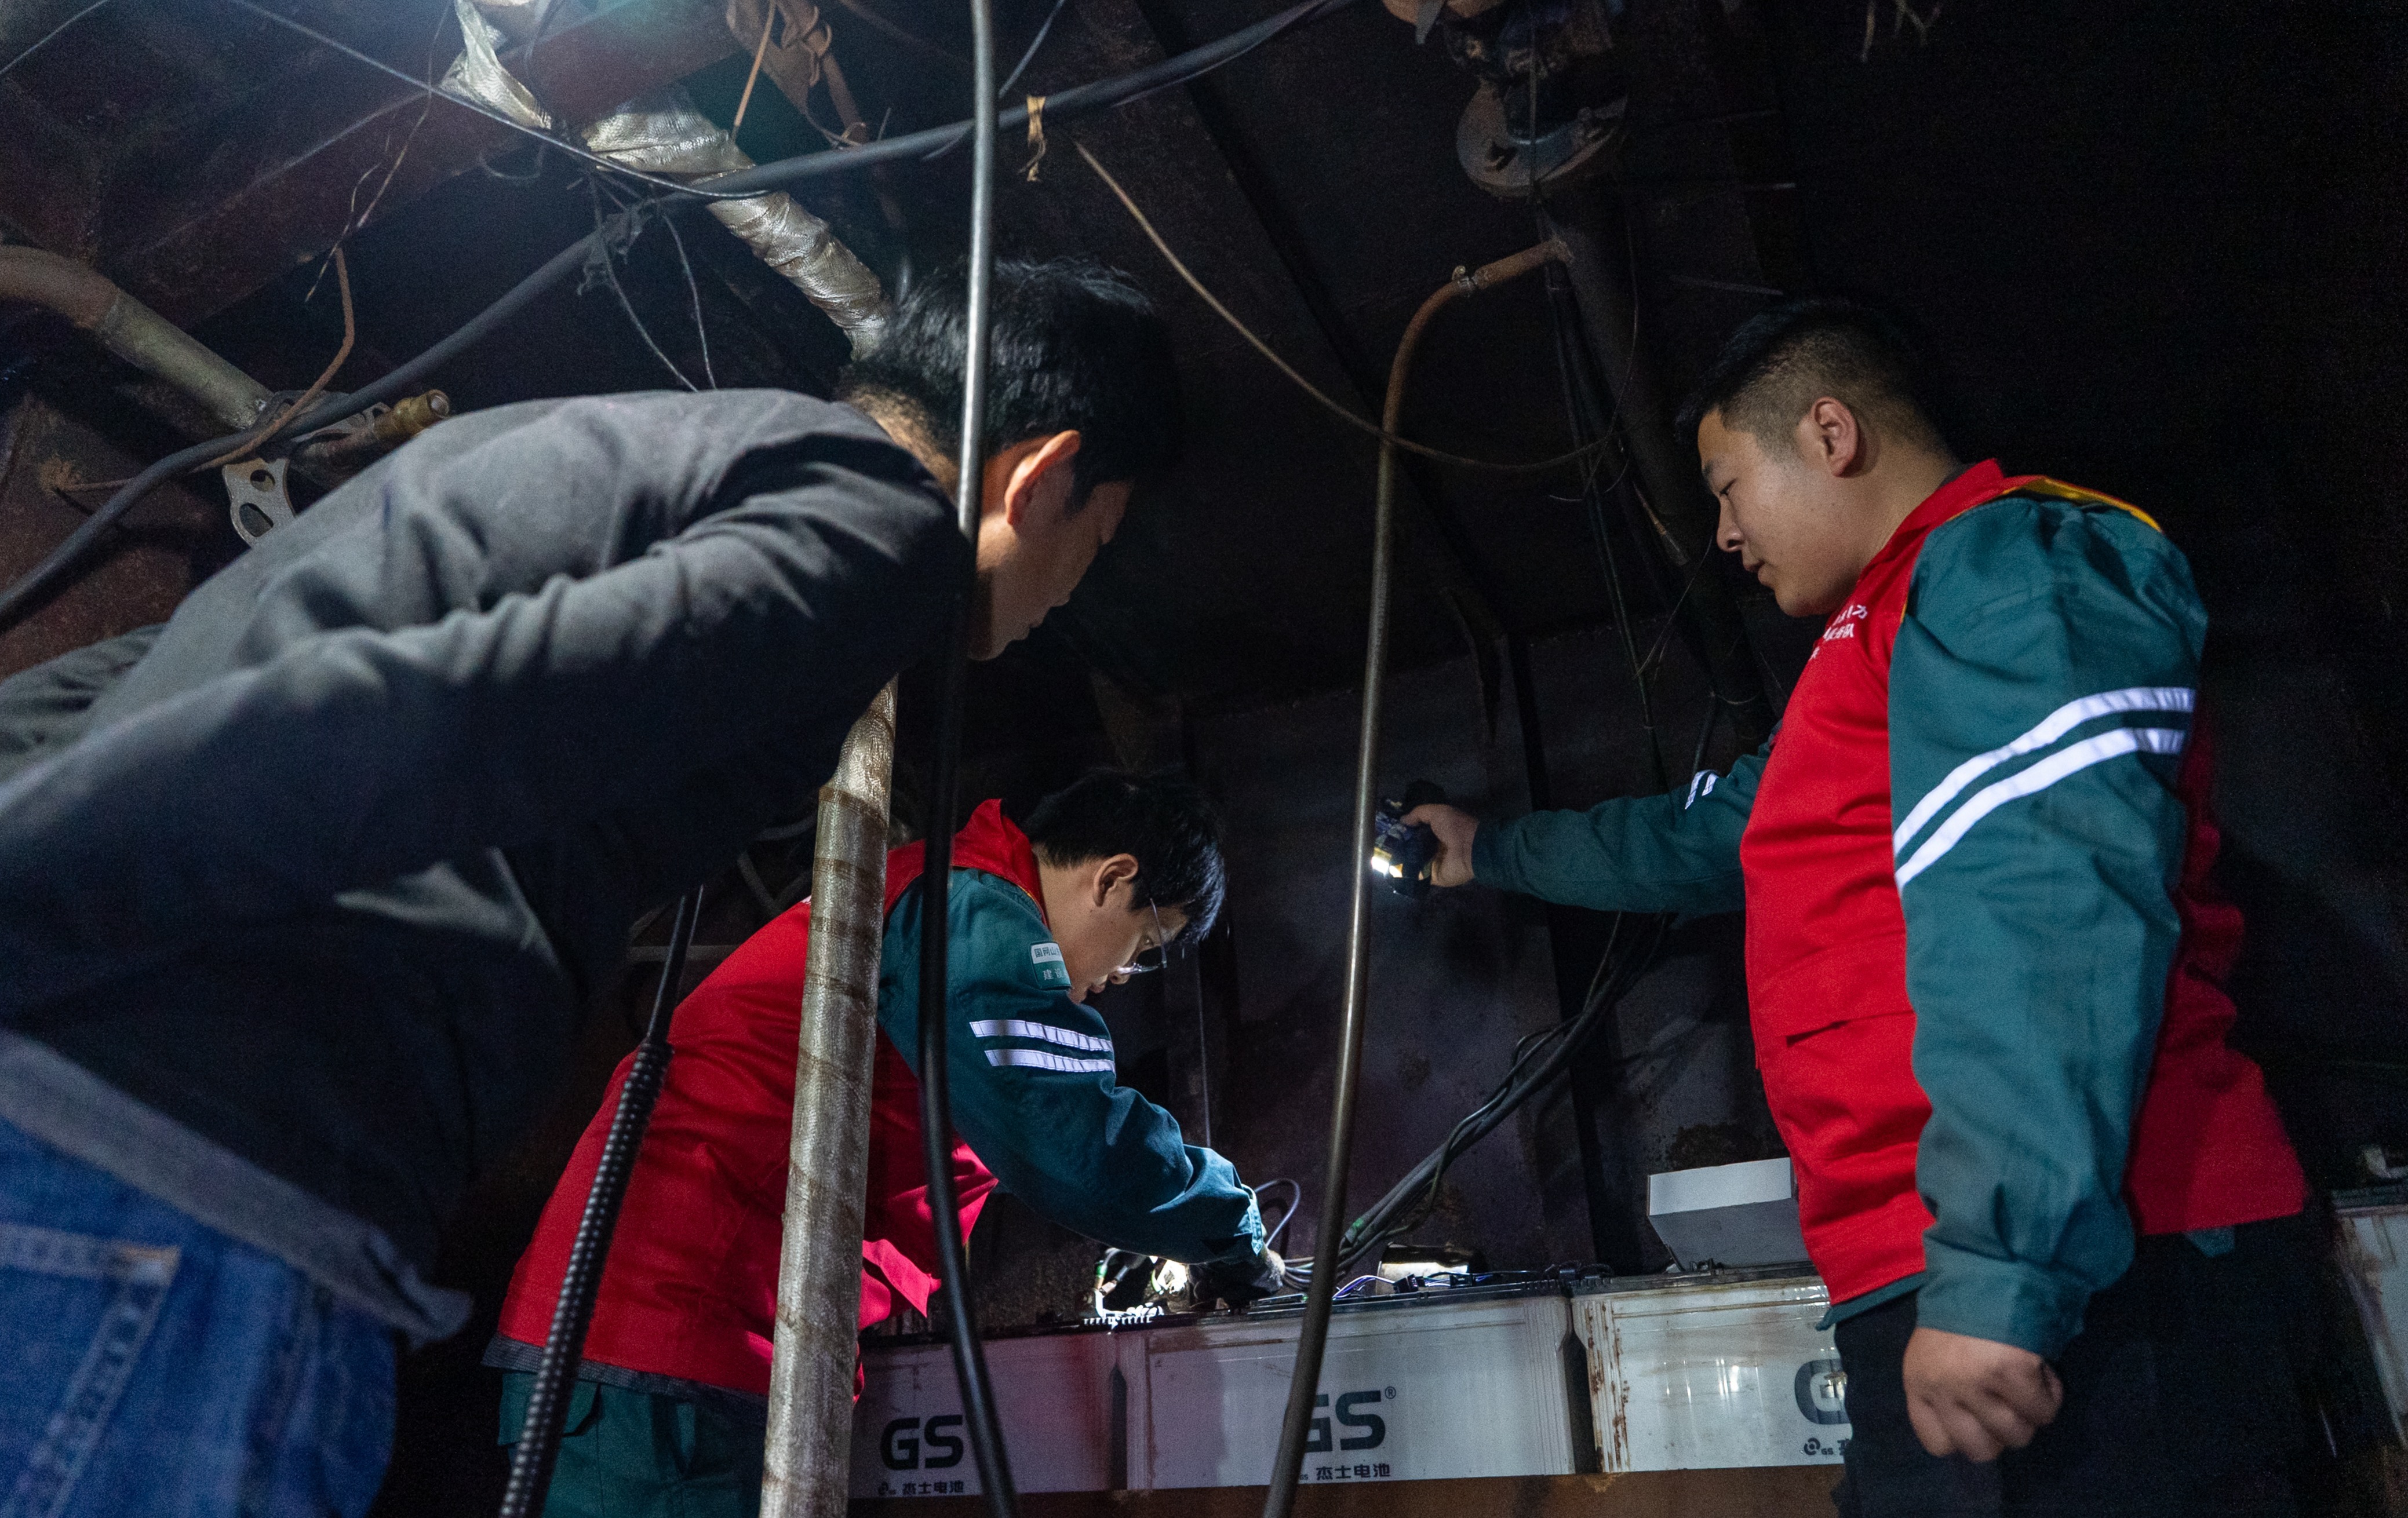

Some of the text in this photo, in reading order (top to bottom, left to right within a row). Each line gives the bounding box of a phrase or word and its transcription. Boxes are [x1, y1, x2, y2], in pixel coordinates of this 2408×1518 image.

[1794, 1359, 1850, 1425] G
[880, 1414, 964, 1470] GS
[902, 1480, 964, 1495] 杰士电池
[1316, 1463, 1391, 1480] 杰士电池
